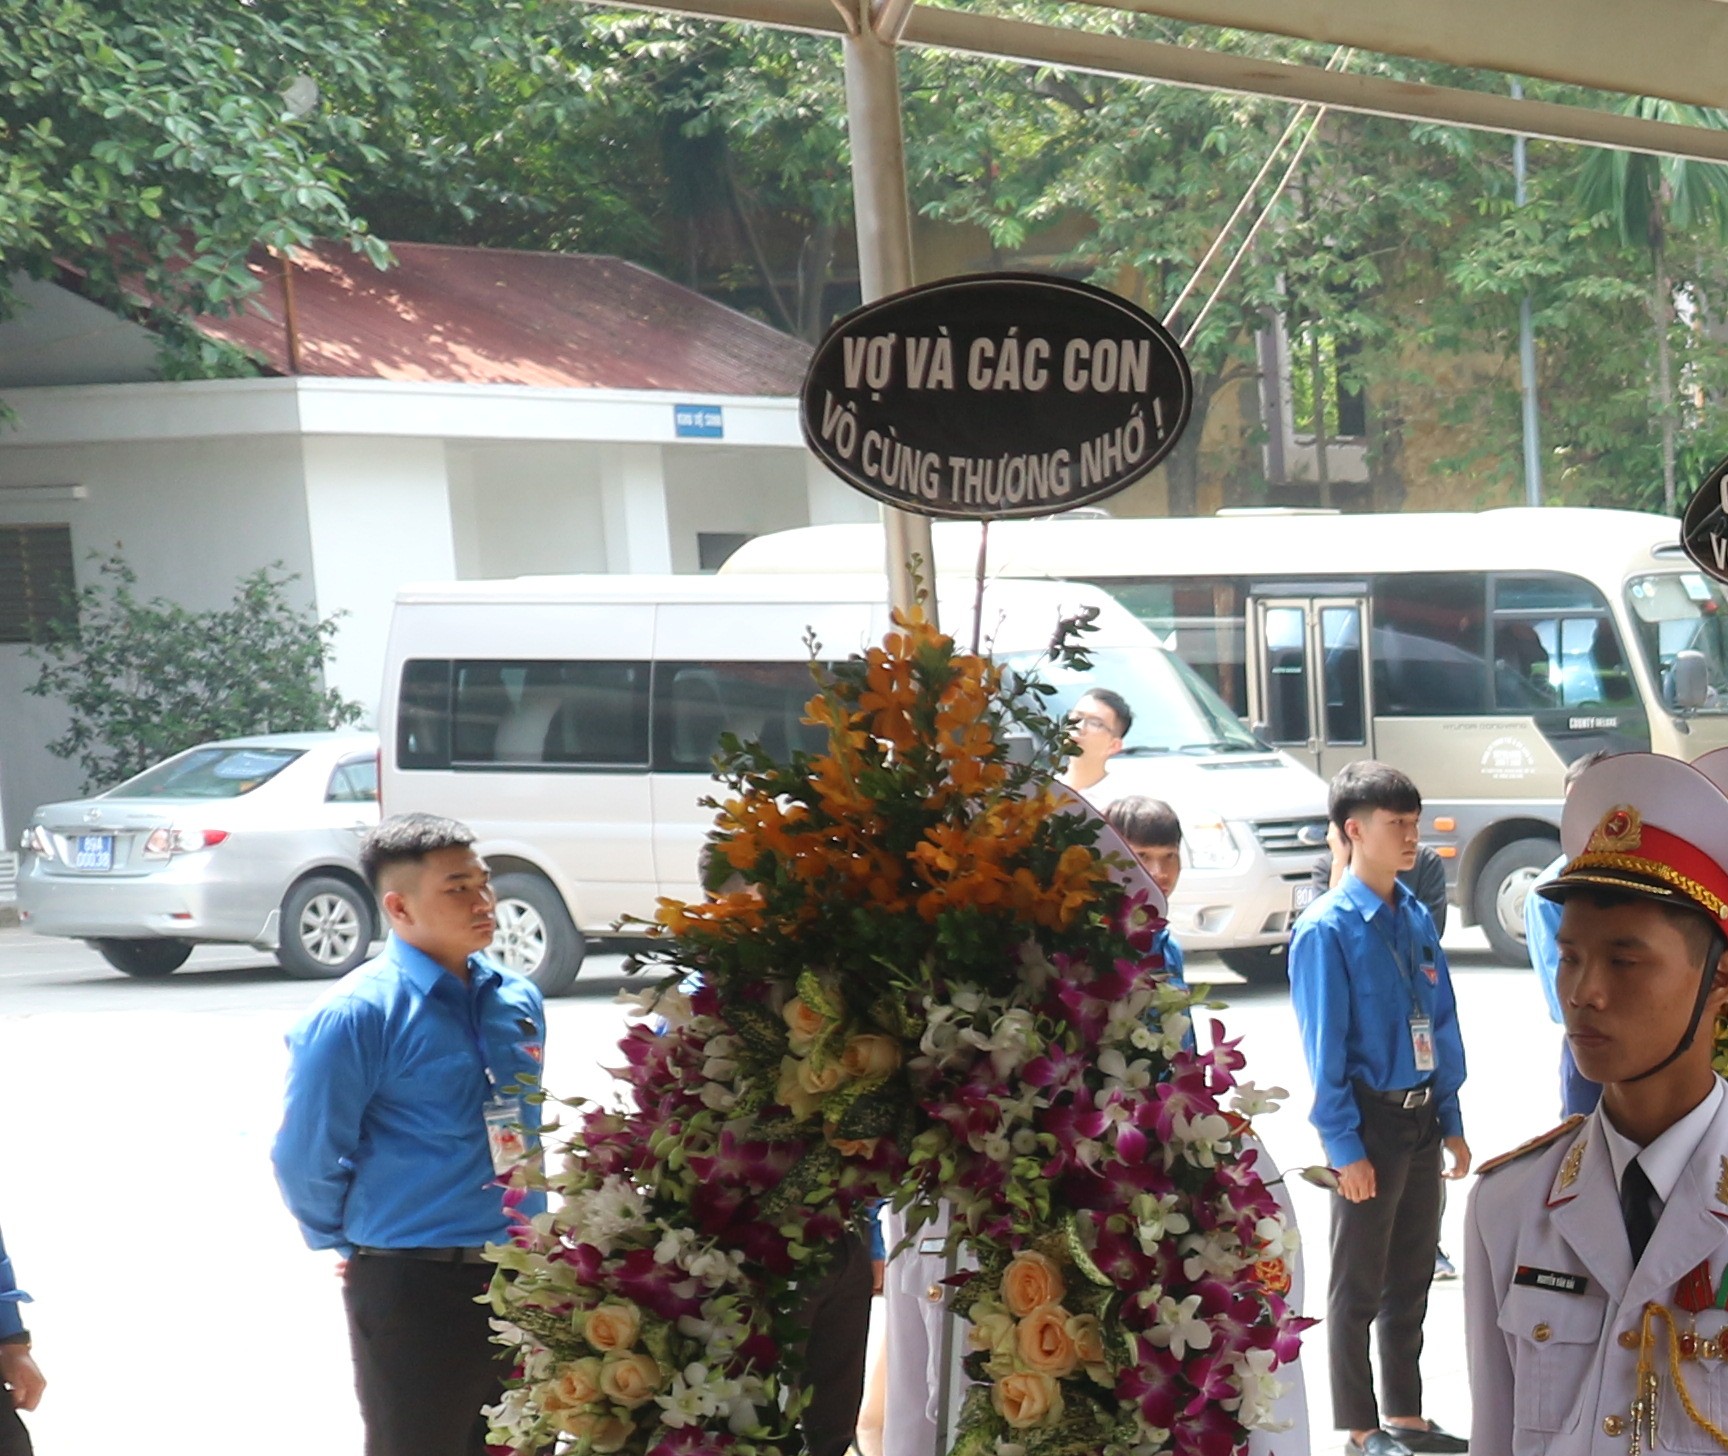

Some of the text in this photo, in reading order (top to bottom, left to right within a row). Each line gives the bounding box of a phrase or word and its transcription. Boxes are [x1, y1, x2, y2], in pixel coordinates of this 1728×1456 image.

[843, 326, 1150, 401] VỢ VÀ CÁC CON
[820, 390, 859, 459] VÔ
[862, 426, 940, 499] CÙNG
[949, 448, 1070, 504] THƯƠNG
[1079, 403, 1147, 488] NHỚ
